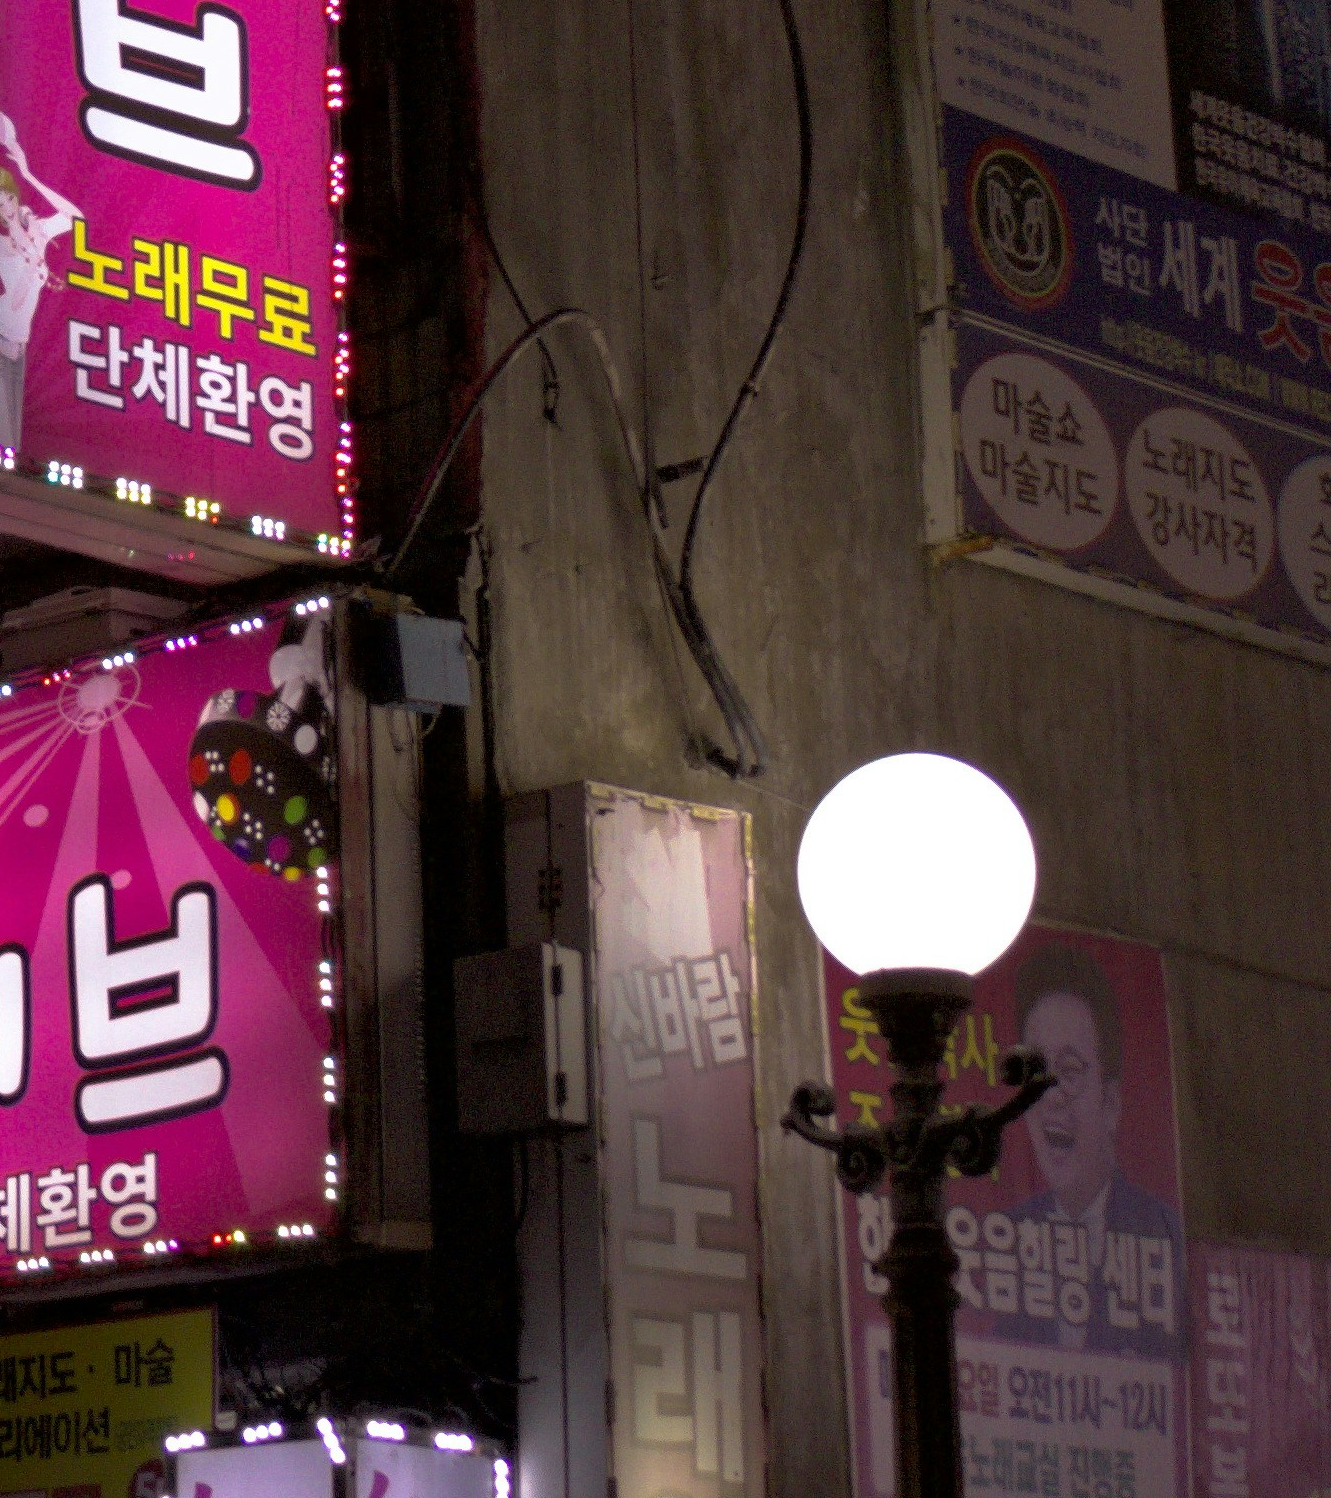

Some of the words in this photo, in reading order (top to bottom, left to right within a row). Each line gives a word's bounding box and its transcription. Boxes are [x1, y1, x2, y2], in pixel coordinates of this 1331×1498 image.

[65, 212, 319, 360] 노래무료
[65, 316, 317, 464] 단체환영
[992, 377, 1085, 447] 마술쇼
[979, 439, 1104, 519] 마술지도
[1142, 427, 1257, 504] 노래지도
[1143, 490, 1259, 574] 강사자격
[1101, 1228, 1178, 1336] 센터
